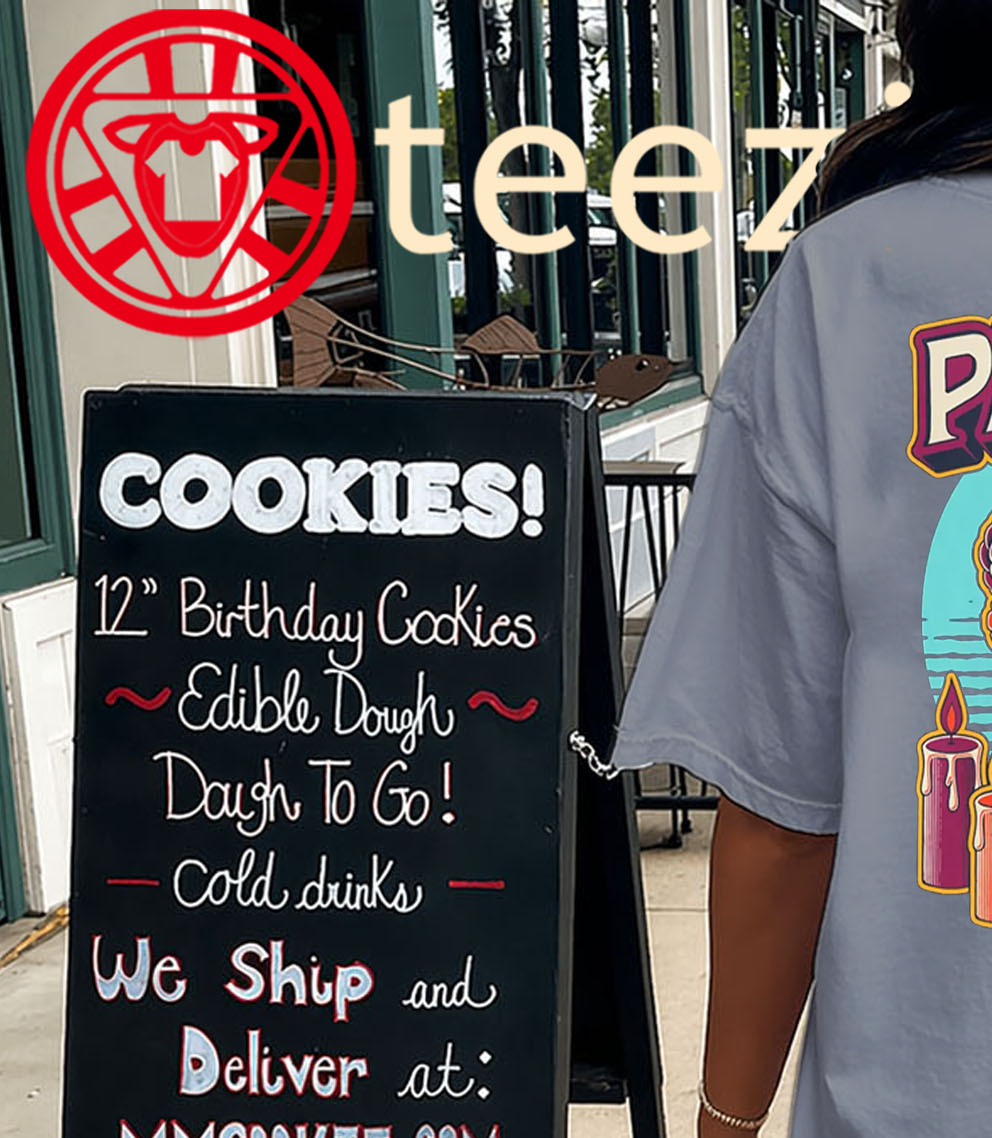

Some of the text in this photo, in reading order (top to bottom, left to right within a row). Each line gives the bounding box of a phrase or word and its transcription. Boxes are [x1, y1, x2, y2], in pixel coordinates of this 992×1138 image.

[99, 452, 545, 538] COOKIES!
[181, 577, 364, 671] Birthday
[178, 662, 455, 755] Edible Dough
[153, 751, 301, 838] Dough
[308, 759, 356, 825] To
[174, 848, 289, 910] Cold
[92, 934, 497, 1023] We Ship and
[180, 1025, 492, 1100] Deliver at:
